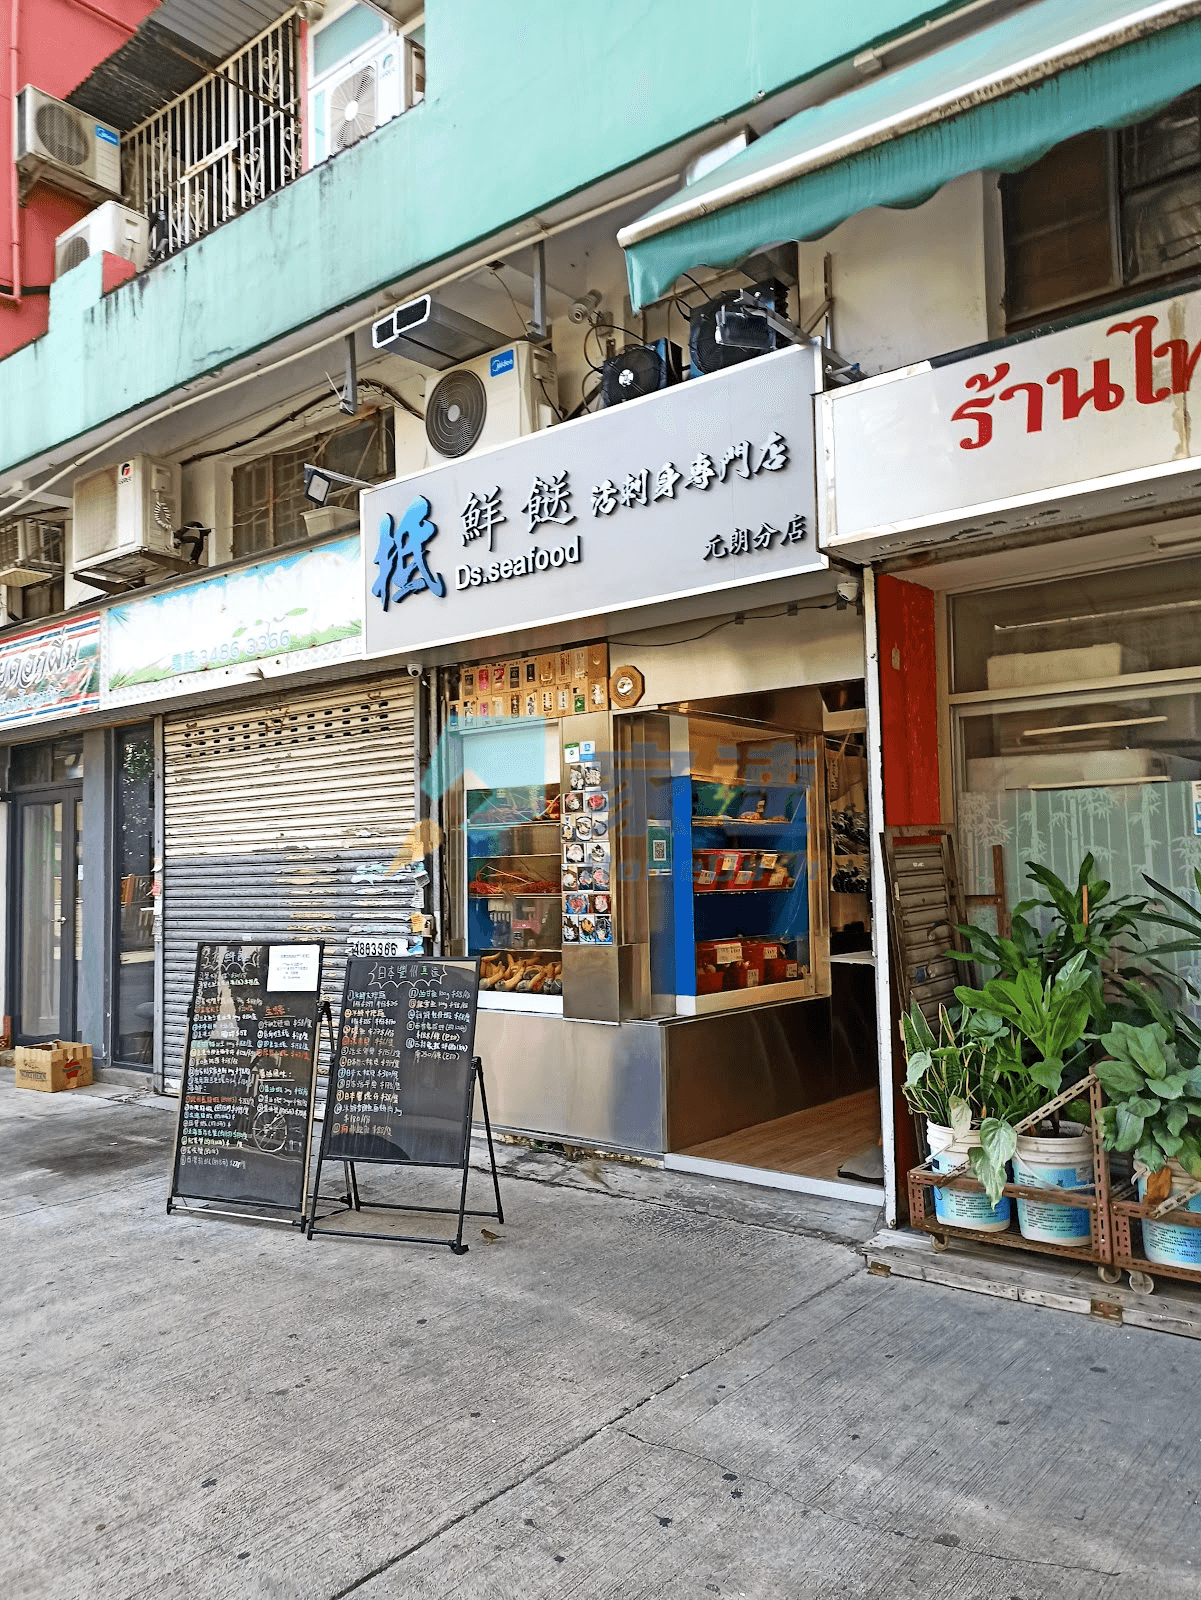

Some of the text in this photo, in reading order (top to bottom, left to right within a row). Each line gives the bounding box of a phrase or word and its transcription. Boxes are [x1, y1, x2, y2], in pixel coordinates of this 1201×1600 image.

[702, 513, 808, 561] 元朗分店
[456, 536, 582, 590] Ds.seafood
[246, 629, 290, 656] 3366
